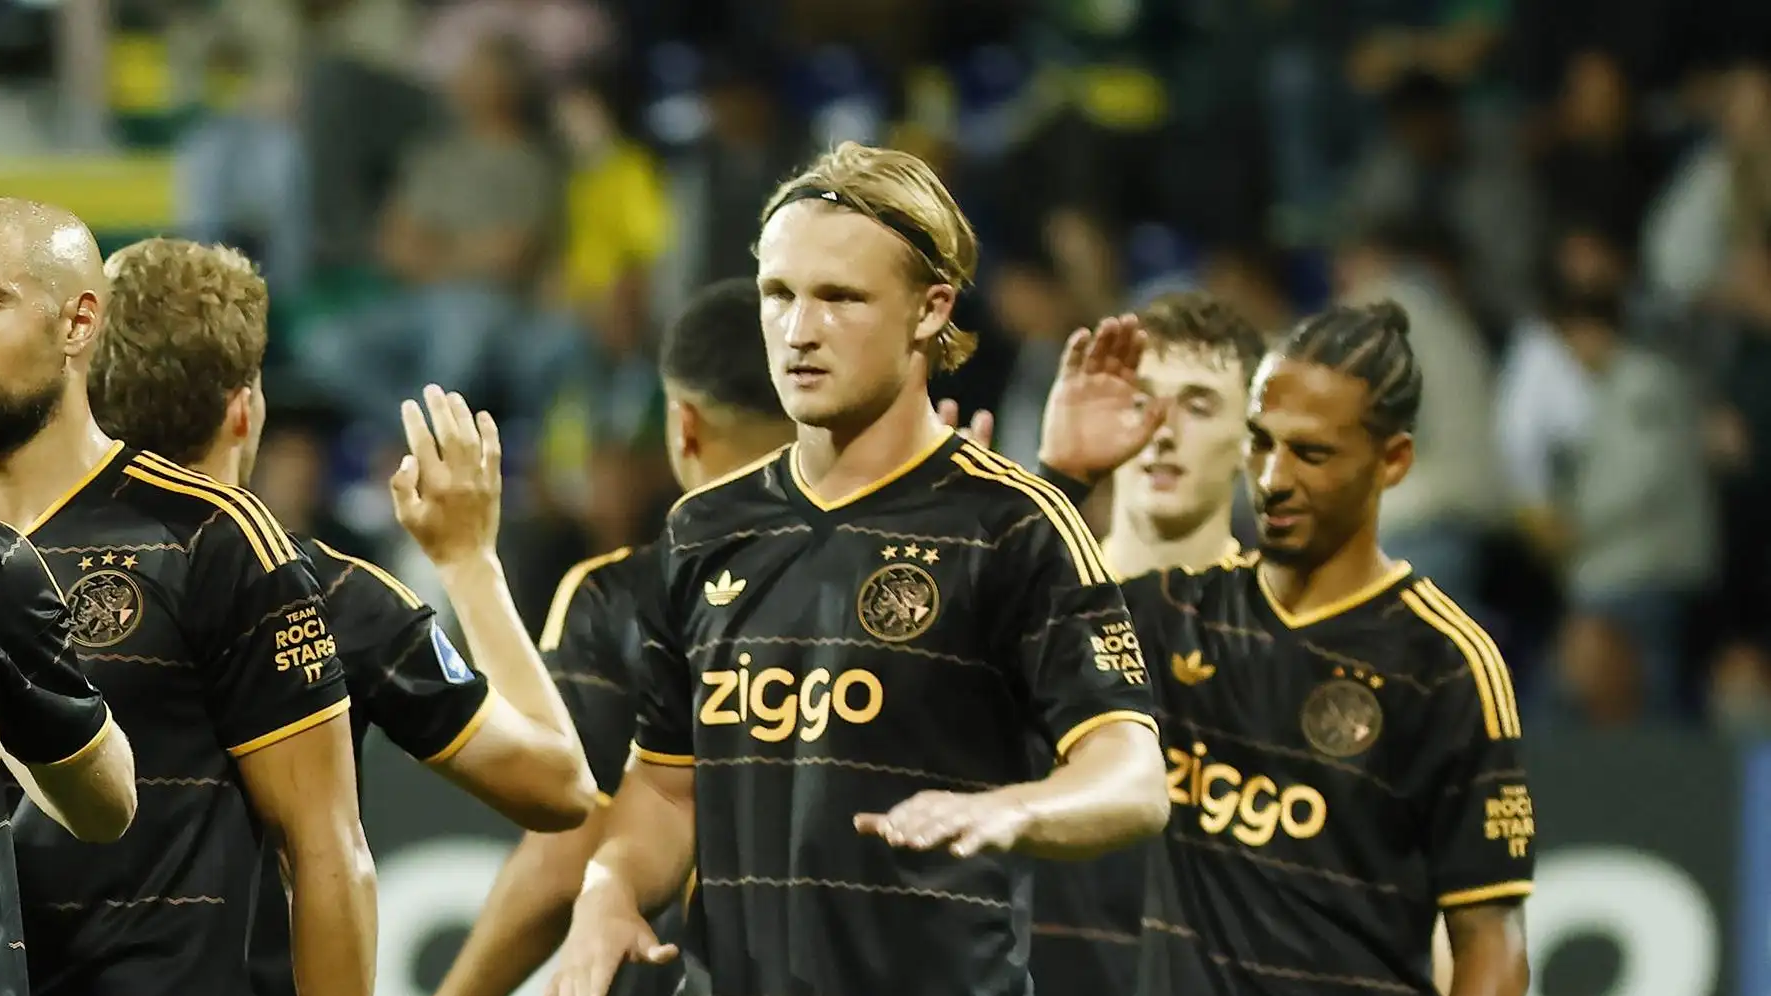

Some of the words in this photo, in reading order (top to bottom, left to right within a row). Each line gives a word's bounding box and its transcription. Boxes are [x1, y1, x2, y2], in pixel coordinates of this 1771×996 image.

[286, 606, 317, 624] TEAM
[275, 634, 337, 672] STARS
[304, 661, 324, 684] IT
[700, 652, 884, 742] ziggo
[1166, 741, 1327, 847] ziggo
